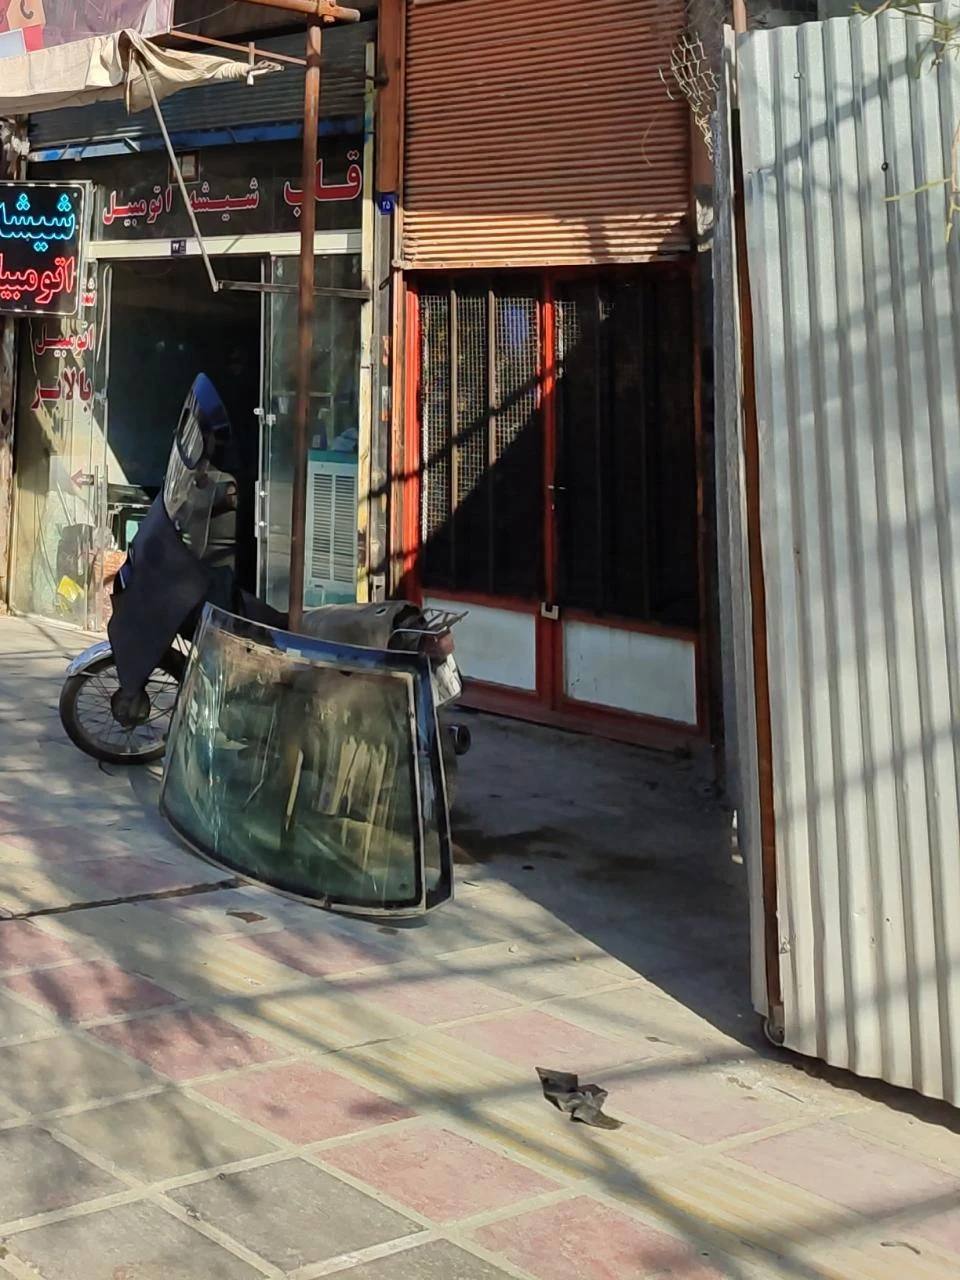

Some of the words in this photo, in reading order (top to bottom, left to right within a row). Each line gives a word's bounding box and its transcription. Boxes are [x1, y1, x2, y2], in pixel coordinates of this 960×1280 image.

[102, 184, 173, 227] اتومبیل
[189, 176, 260, 222] شیشه
[34, 320, 96, 359] اتومبیل
